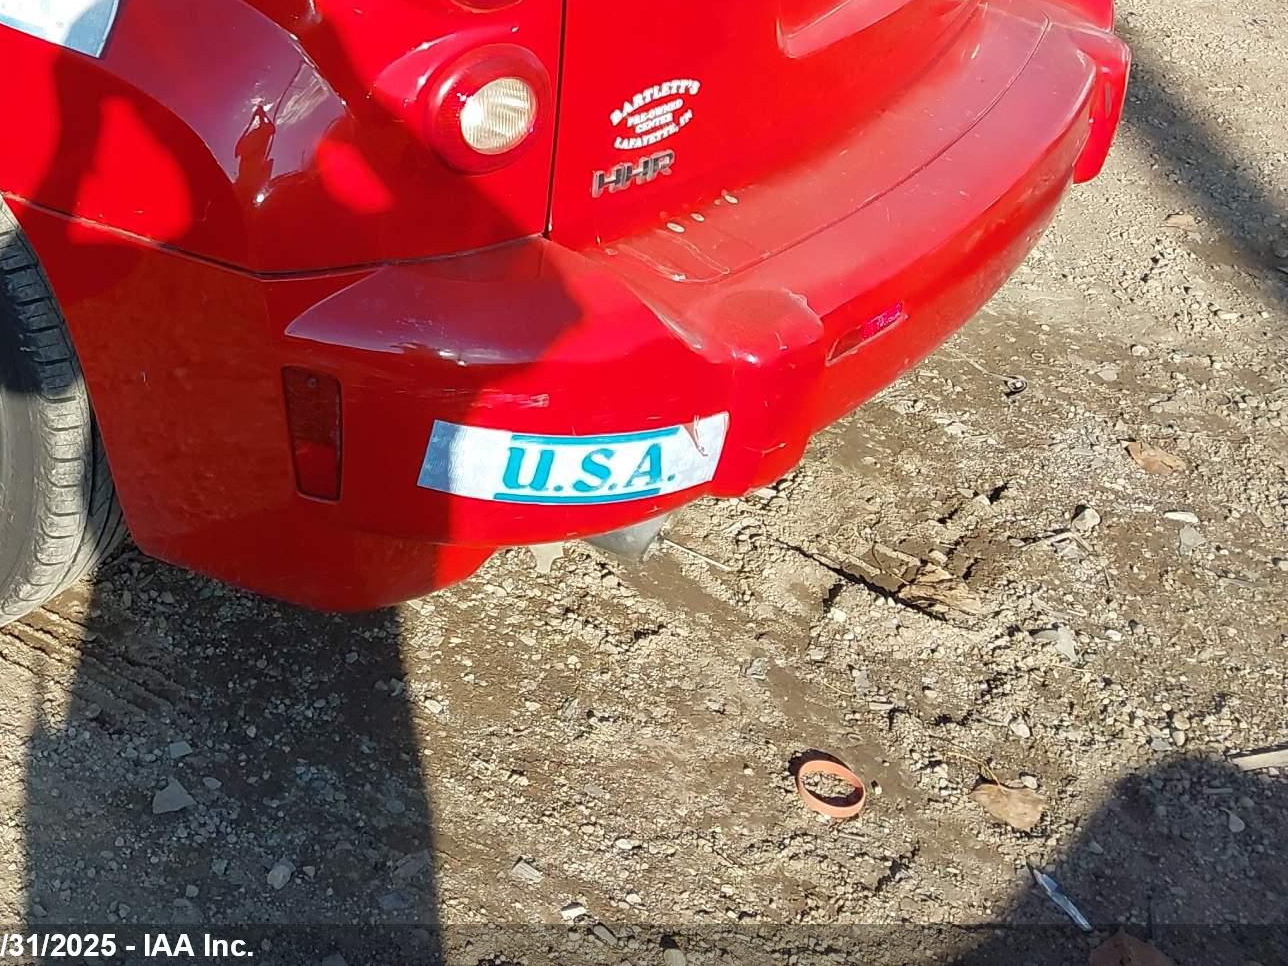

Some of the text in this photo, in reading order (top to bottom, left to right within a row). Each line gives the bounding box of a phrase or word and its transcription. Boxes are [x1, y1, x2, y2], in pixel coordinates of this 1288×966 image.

[609, 79, 700, 126] BARTLETT'S
[591, 149, 675, 198] HHR
[501, 443, 676, 492] U.S.A.
